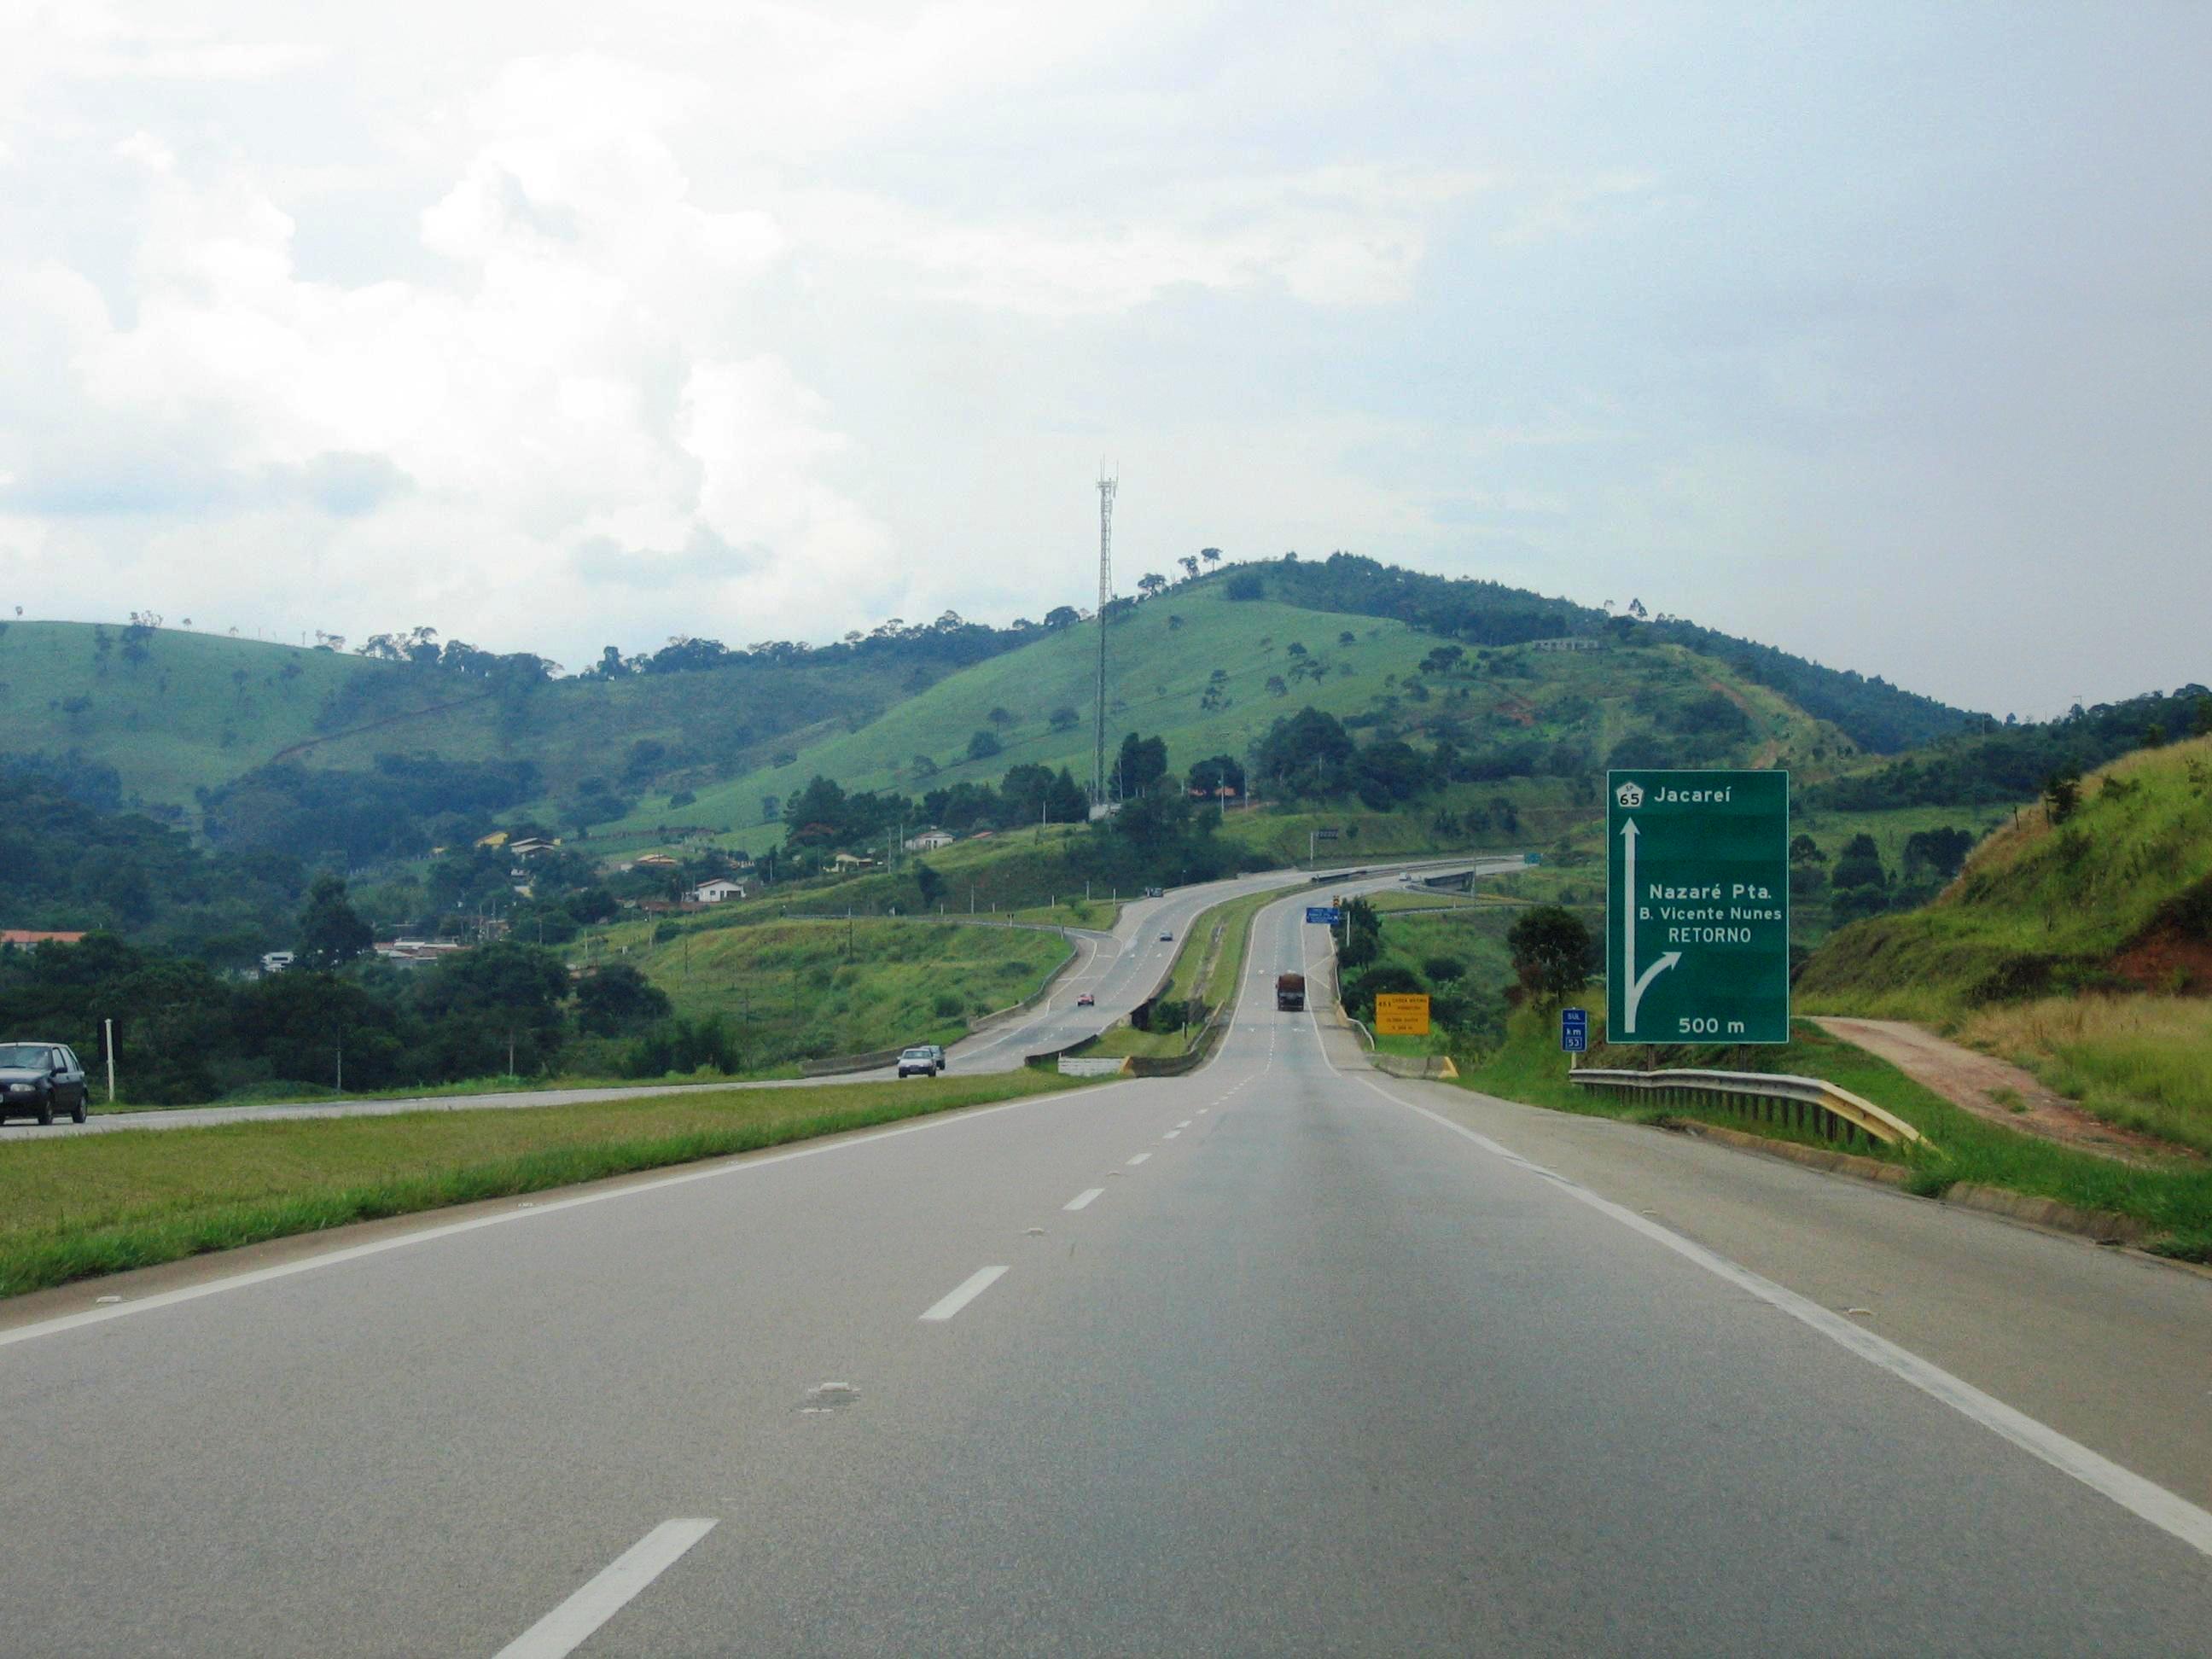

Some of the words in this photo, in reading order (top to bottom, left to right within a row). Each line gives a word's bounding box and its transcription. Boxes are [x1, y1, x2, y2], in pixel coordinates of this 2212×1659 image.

[1620, 793, 1639, 806] 65
[1654, 786, 1731, 802] Jacareí
[1650, 883, 1721, 899] Nazaré
[1661, 907, 1724, 920] Vicente
[1731, 907, 1782, 920] Nunes
[1668, 927, 1751, 943] RETORNO
[1679, 1017, 1719, 1033] 500
[1727, 1022, 1744, 1033] m
